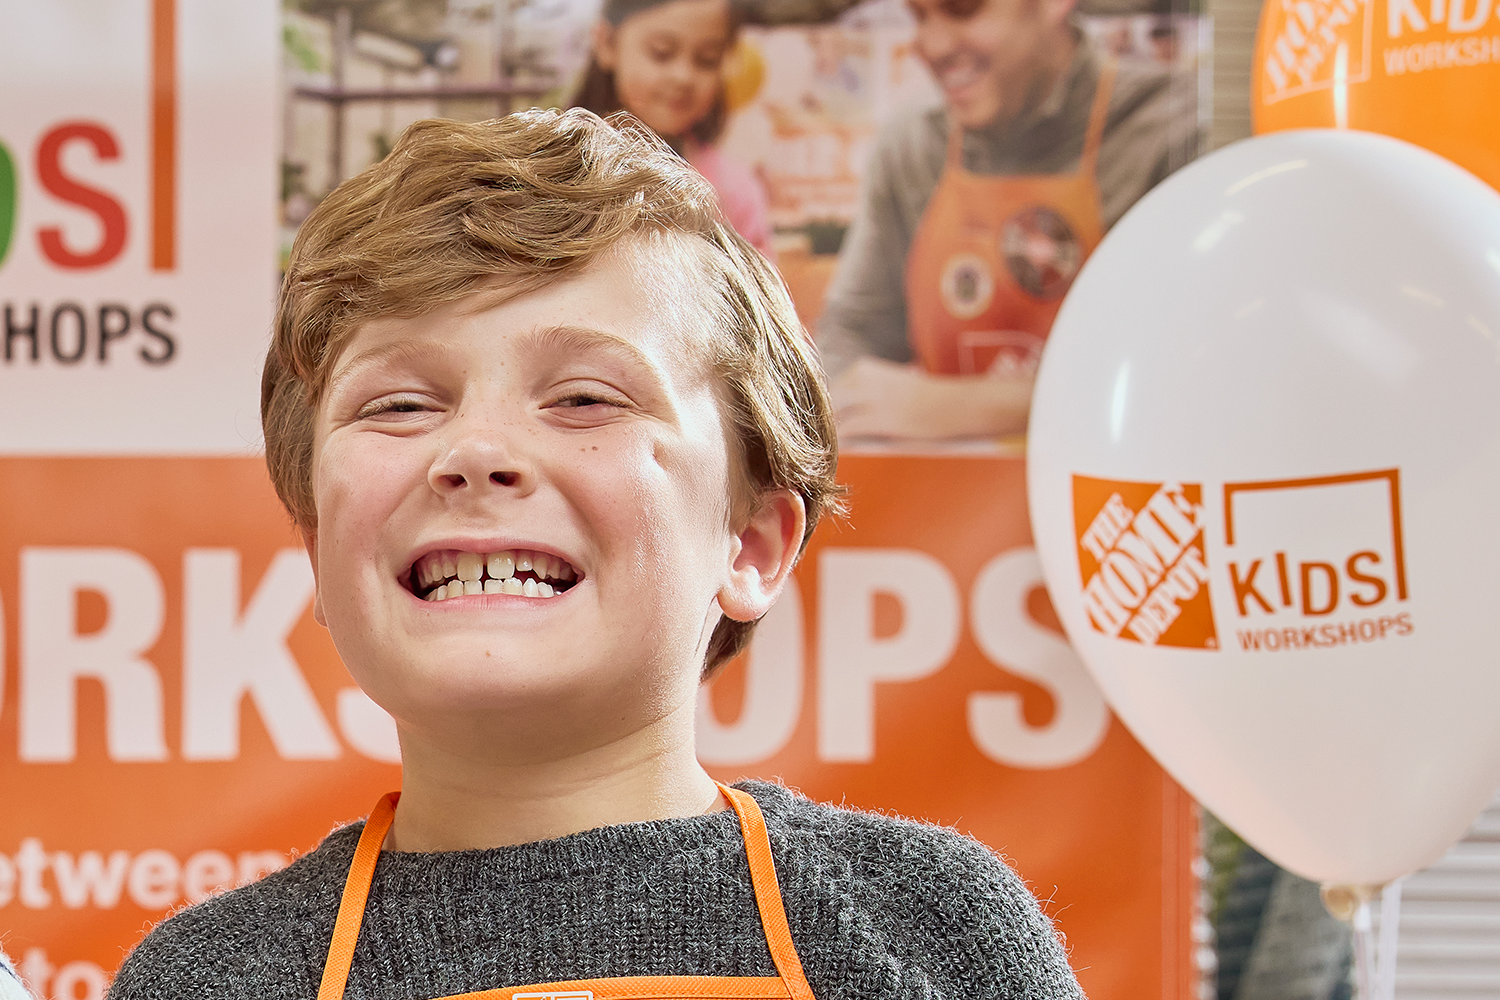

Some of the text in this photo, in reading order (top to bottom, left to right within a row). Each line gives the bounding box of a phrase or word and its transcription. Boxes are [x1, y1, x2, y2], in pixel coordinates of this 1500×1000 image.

[1079, 491, 1135, 565] THE
[1082, 482, 1206, 638] HOME
[1128, 543, 1209, 645] DEPOT
[1227, 550, 1389, 618] KIDS
[1237, 612, 1415, 653] WORKSHOPS
